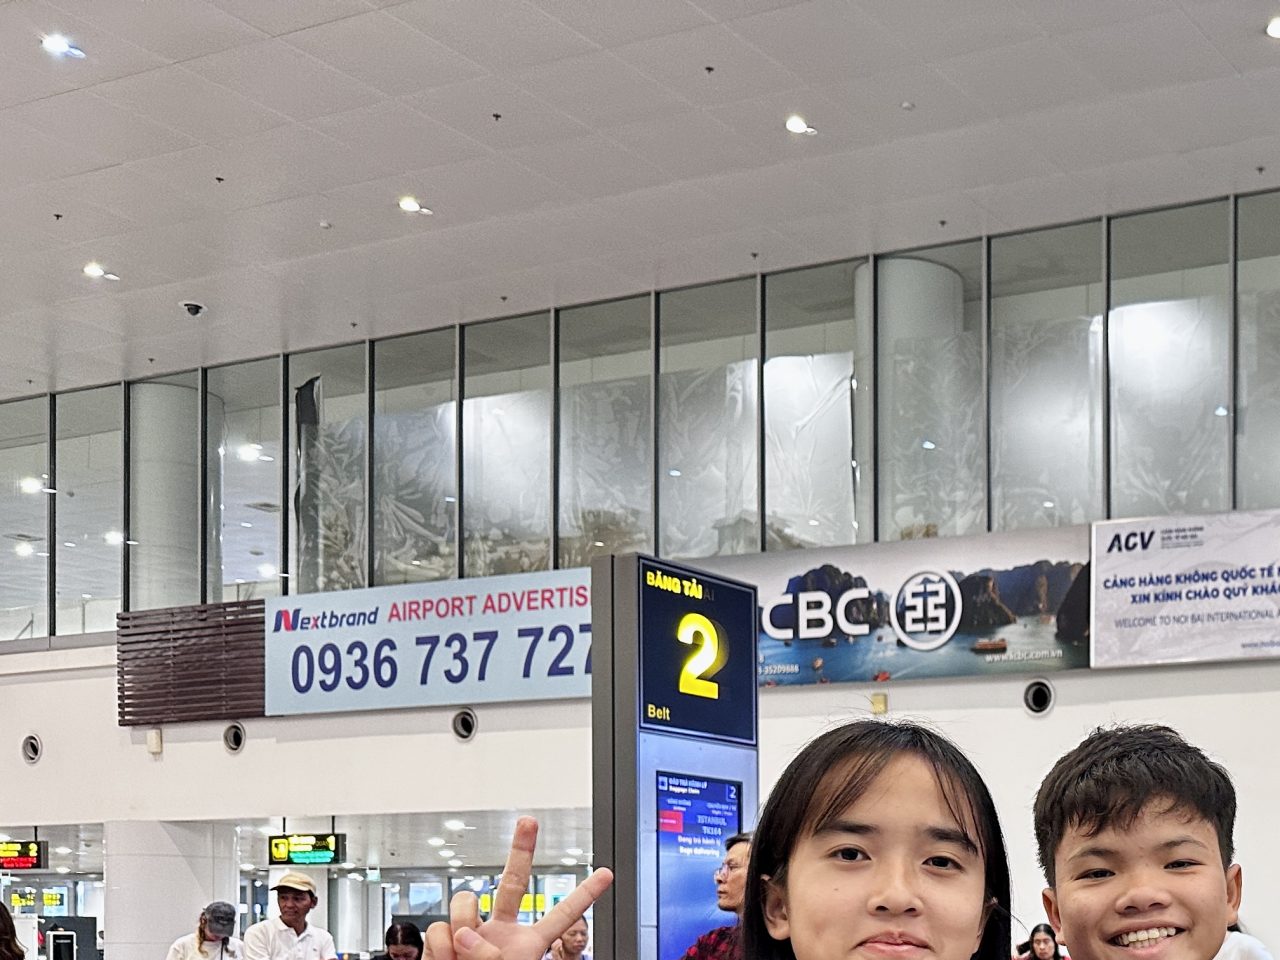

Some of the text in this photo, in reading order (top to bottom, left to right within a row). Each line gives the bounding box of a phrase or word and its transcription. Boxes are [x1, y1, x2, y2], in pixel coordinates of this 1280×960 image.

[1107, 530, 1155, 553] ACV
[647, 570, 703, 600] BĂNG TẢI
[1103, 574, 1136, 589] CẢNG
[1139, 572, 1172, 586] HÀNG
[1175, 570, 1218, 584] KHÔNG
[1221, 564, 1256, 582] QUỐC
[1260, 562, 1275, 578] TẾ
[1131, 593, 1150, 604] XIN
[1154, 589, 1182, 603] KÍNH
[1186, 586, 1219, 600] CHÀO
[273, 606, 379, 633] Nextbrand
[388, 594, 477, 623] AIRPORT
[762, 587, 870, 640] CBC
[1115, 616, 1157, 629] WELCOME
[1160, 615, 1171, 626] TO
[1173, 614, 1188, 625] NOI
[1190, 613, 1204, 624] BAI
[1207, 609, 1274, 623] INTERNATIONAL
[291, 638, 397, 694] 0936
[415, 630, 499, 685] 737
[677, 612, 722, 700] 2
[647, 704, 671, 721] Belt
[729, 786, 736, 799] 2
